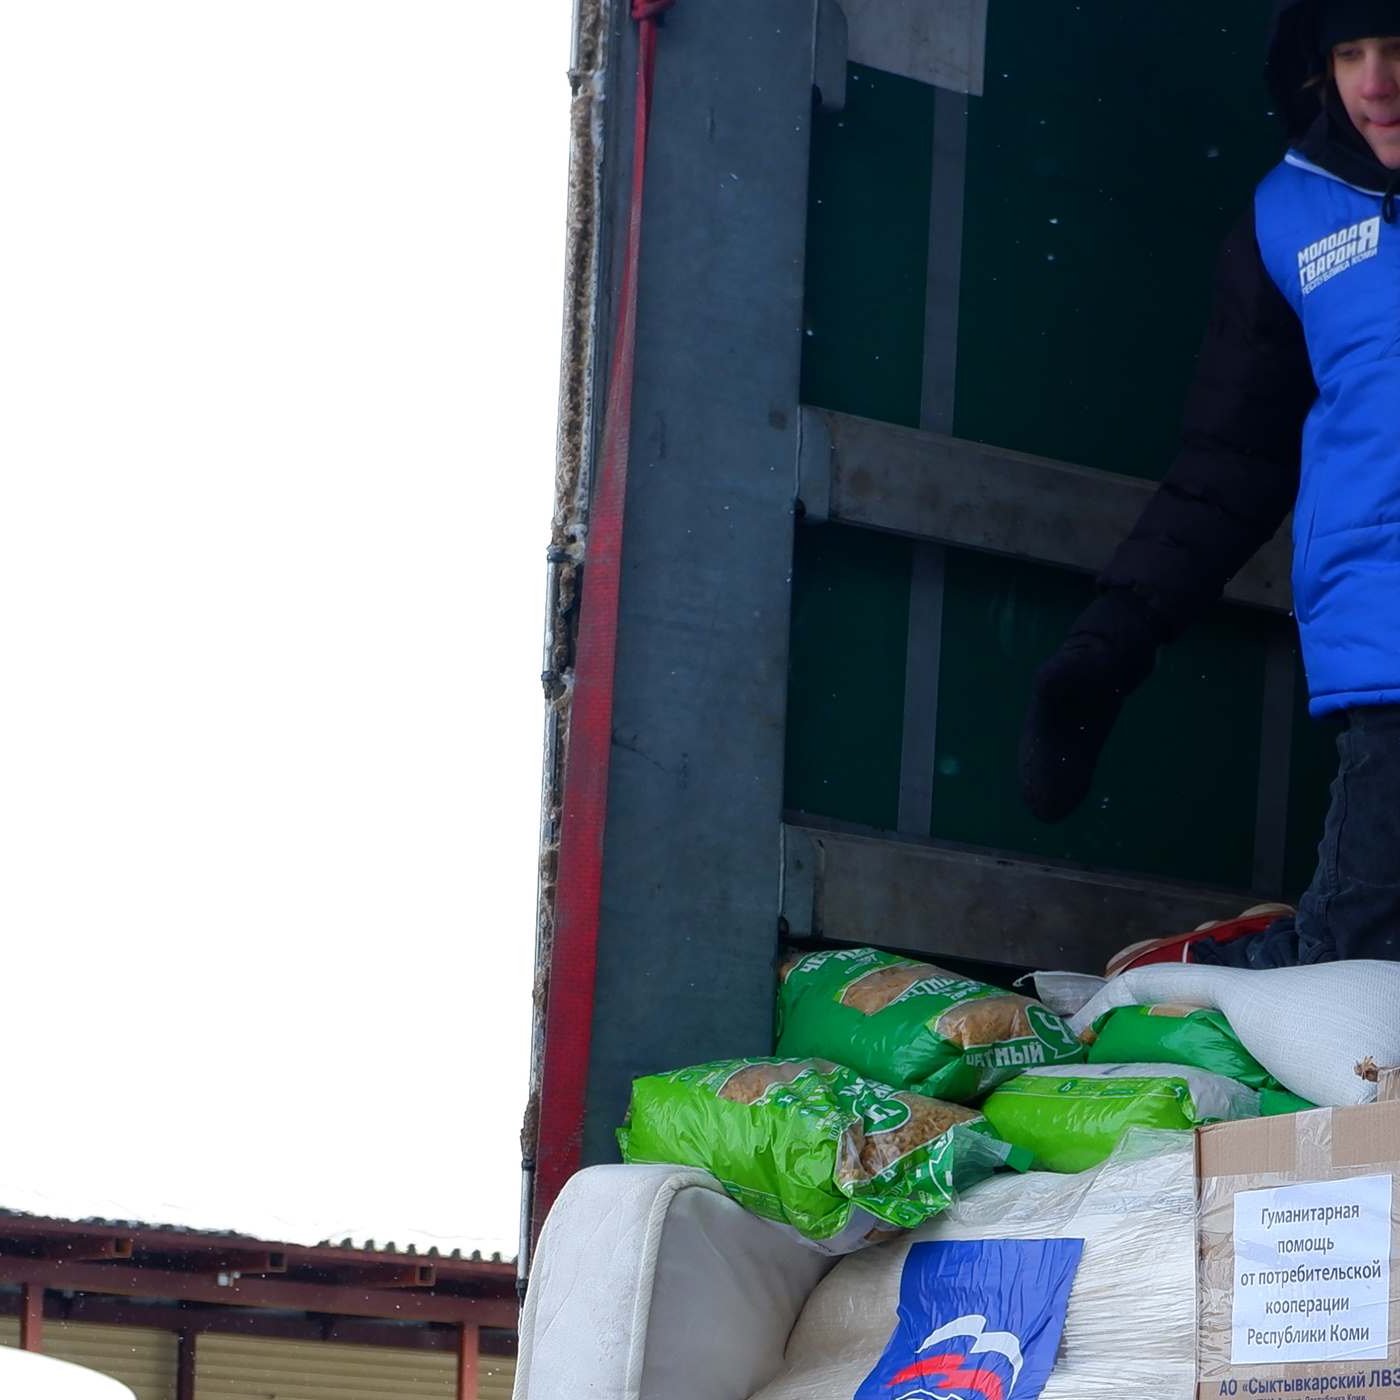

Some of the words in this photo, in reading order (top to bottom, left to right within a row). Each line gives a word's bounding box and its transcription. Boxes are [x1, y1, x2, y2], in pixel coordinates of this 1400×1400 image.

[1298, 216, 1380, 268] МОЛОДАЯ
[1261, 1205, 1359, 1230] Гуманитарная
[1278, 1237, 1334, 1255] помощь
[1241, 1273, 1255, 1286] от
[1258, 1259, 1381, 1288] потребительской
[1265, 1297, 1350, 1317] кооперации
[1247, 1326, 1326, 1348] Республики
[1330, 1325, 1370, 1341] Коми
[1219, 1379, 1238, 1396] АО
[1243, 1372, 1366, 1395] «Сыктывкарский
